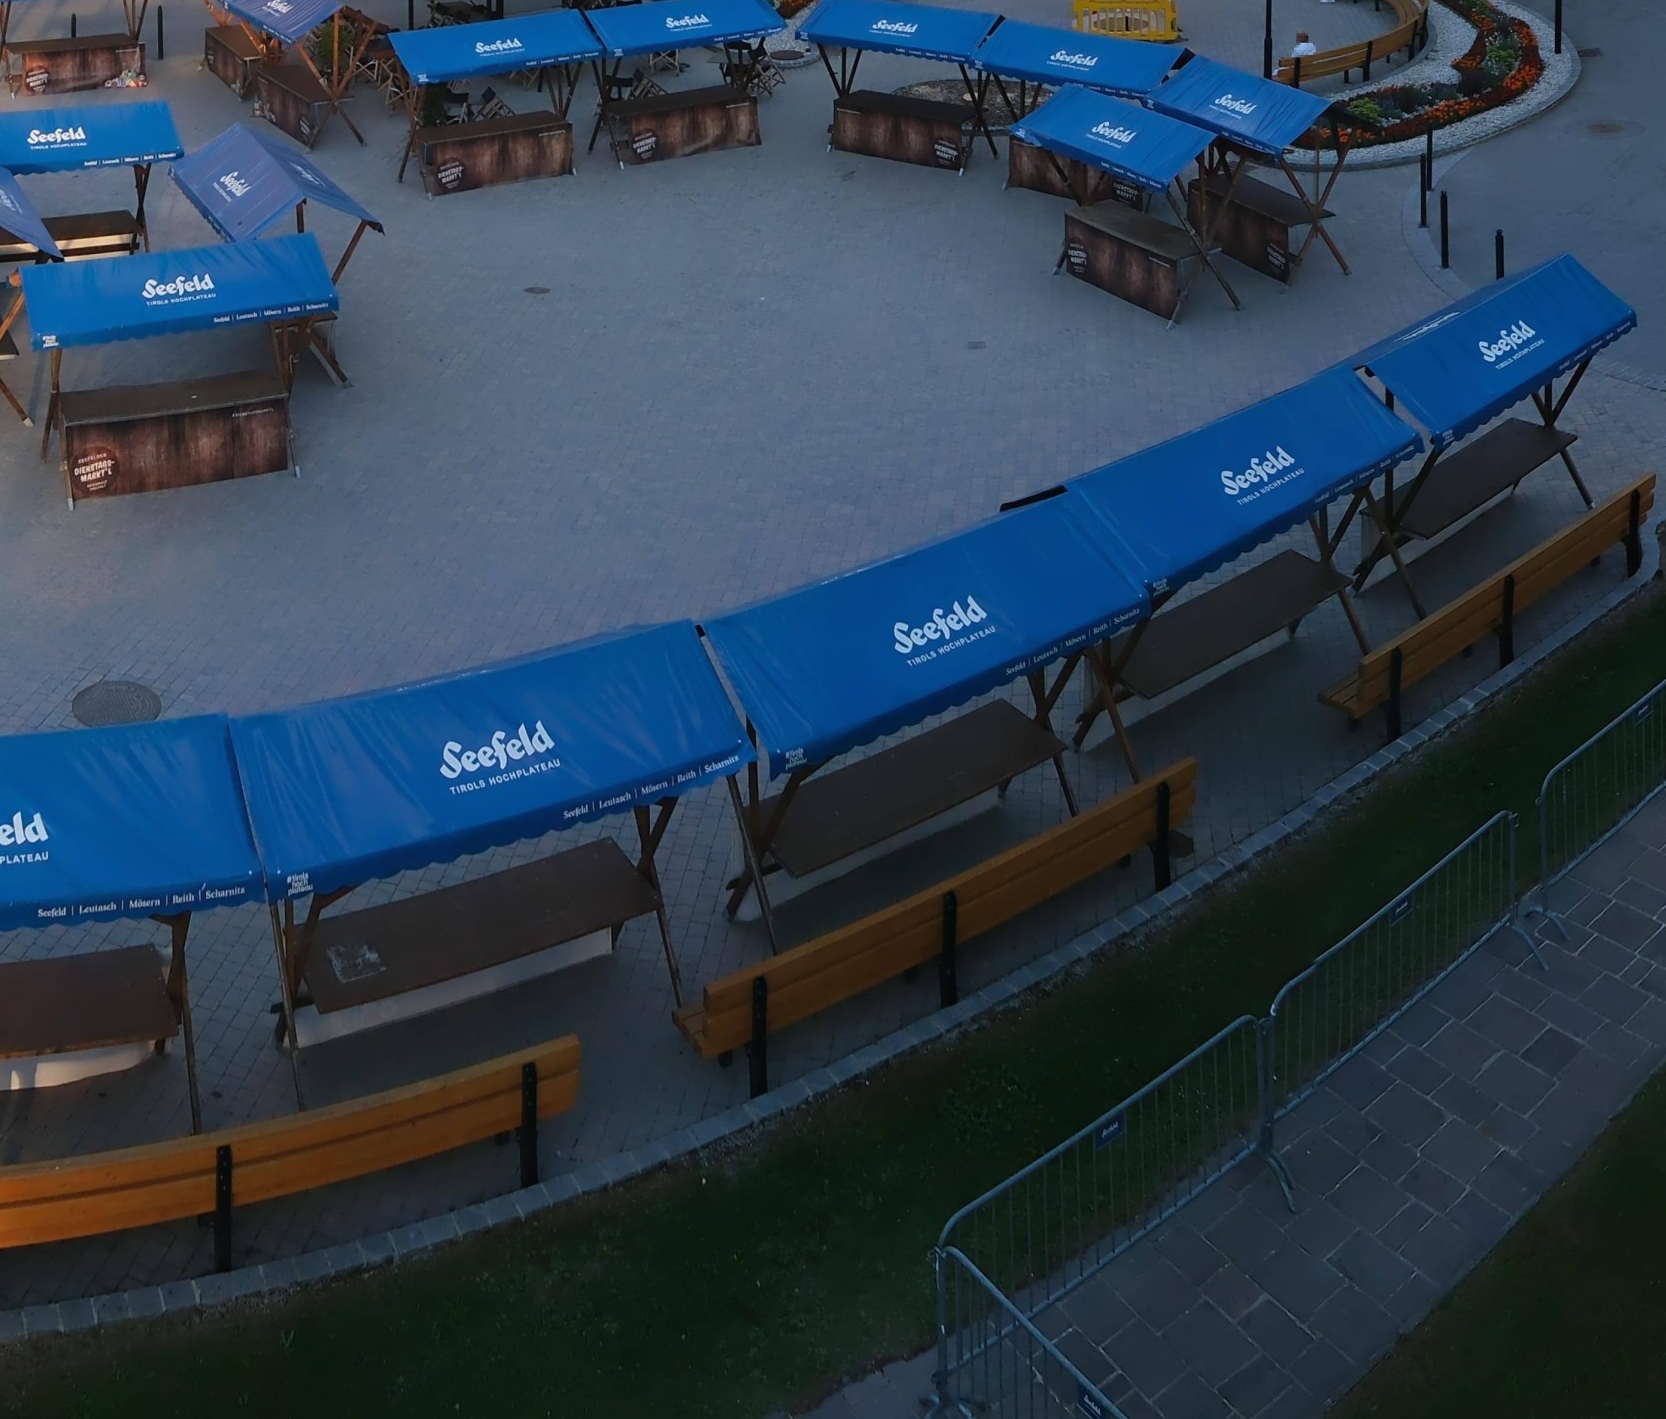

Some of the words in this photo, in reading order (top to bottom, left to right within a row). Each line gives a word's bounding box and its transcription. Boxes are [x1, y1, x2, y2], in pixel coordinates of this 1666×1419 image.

[665, 13, 710, 29] Seefeld
[872, 20, 919, 33] Seefeld
[475, 37, 522, 54] Seefeld
[1049, 49, 1098, 68] Seefeld
[1215, 94, 1257, 115] Seefeld
[27, 126, 86, 144] Seefeld
[1092, 121, 1137, 144] Seefeld
[142, 273, 215, 300] Seefeld
[1478, 320, 1535, 362] Seefeld
[1220, 445, 1295, 495] Seefeld
[893, 594, 988, 655] Seefeld
[906, 650, 937, 667] TIROLS
[938, 625, 997, 656] HOCHPLATEAU
[439, 719, 556, 779] Seefeld
[449, 778, 487, 796] TIROLS
[489, 757, 561, 789] HOCHPLATEAU
[563, 804, 589, 820] Seefeld
[599, 791, 631, 810] Leutasch
[640, 779, 668, 796] Mösern
[677, 769, 696, 784] Reith
[704, 754, 740, 774] Scharnitz
[38, 907, 67, 919] Seefeld
[79, 901, 117, 915] Leutasch
[129, 897, 161, 909] Mösern
[172, 893, 195, 904] Reith
[205, 886, 245, 900] Scharnitz
